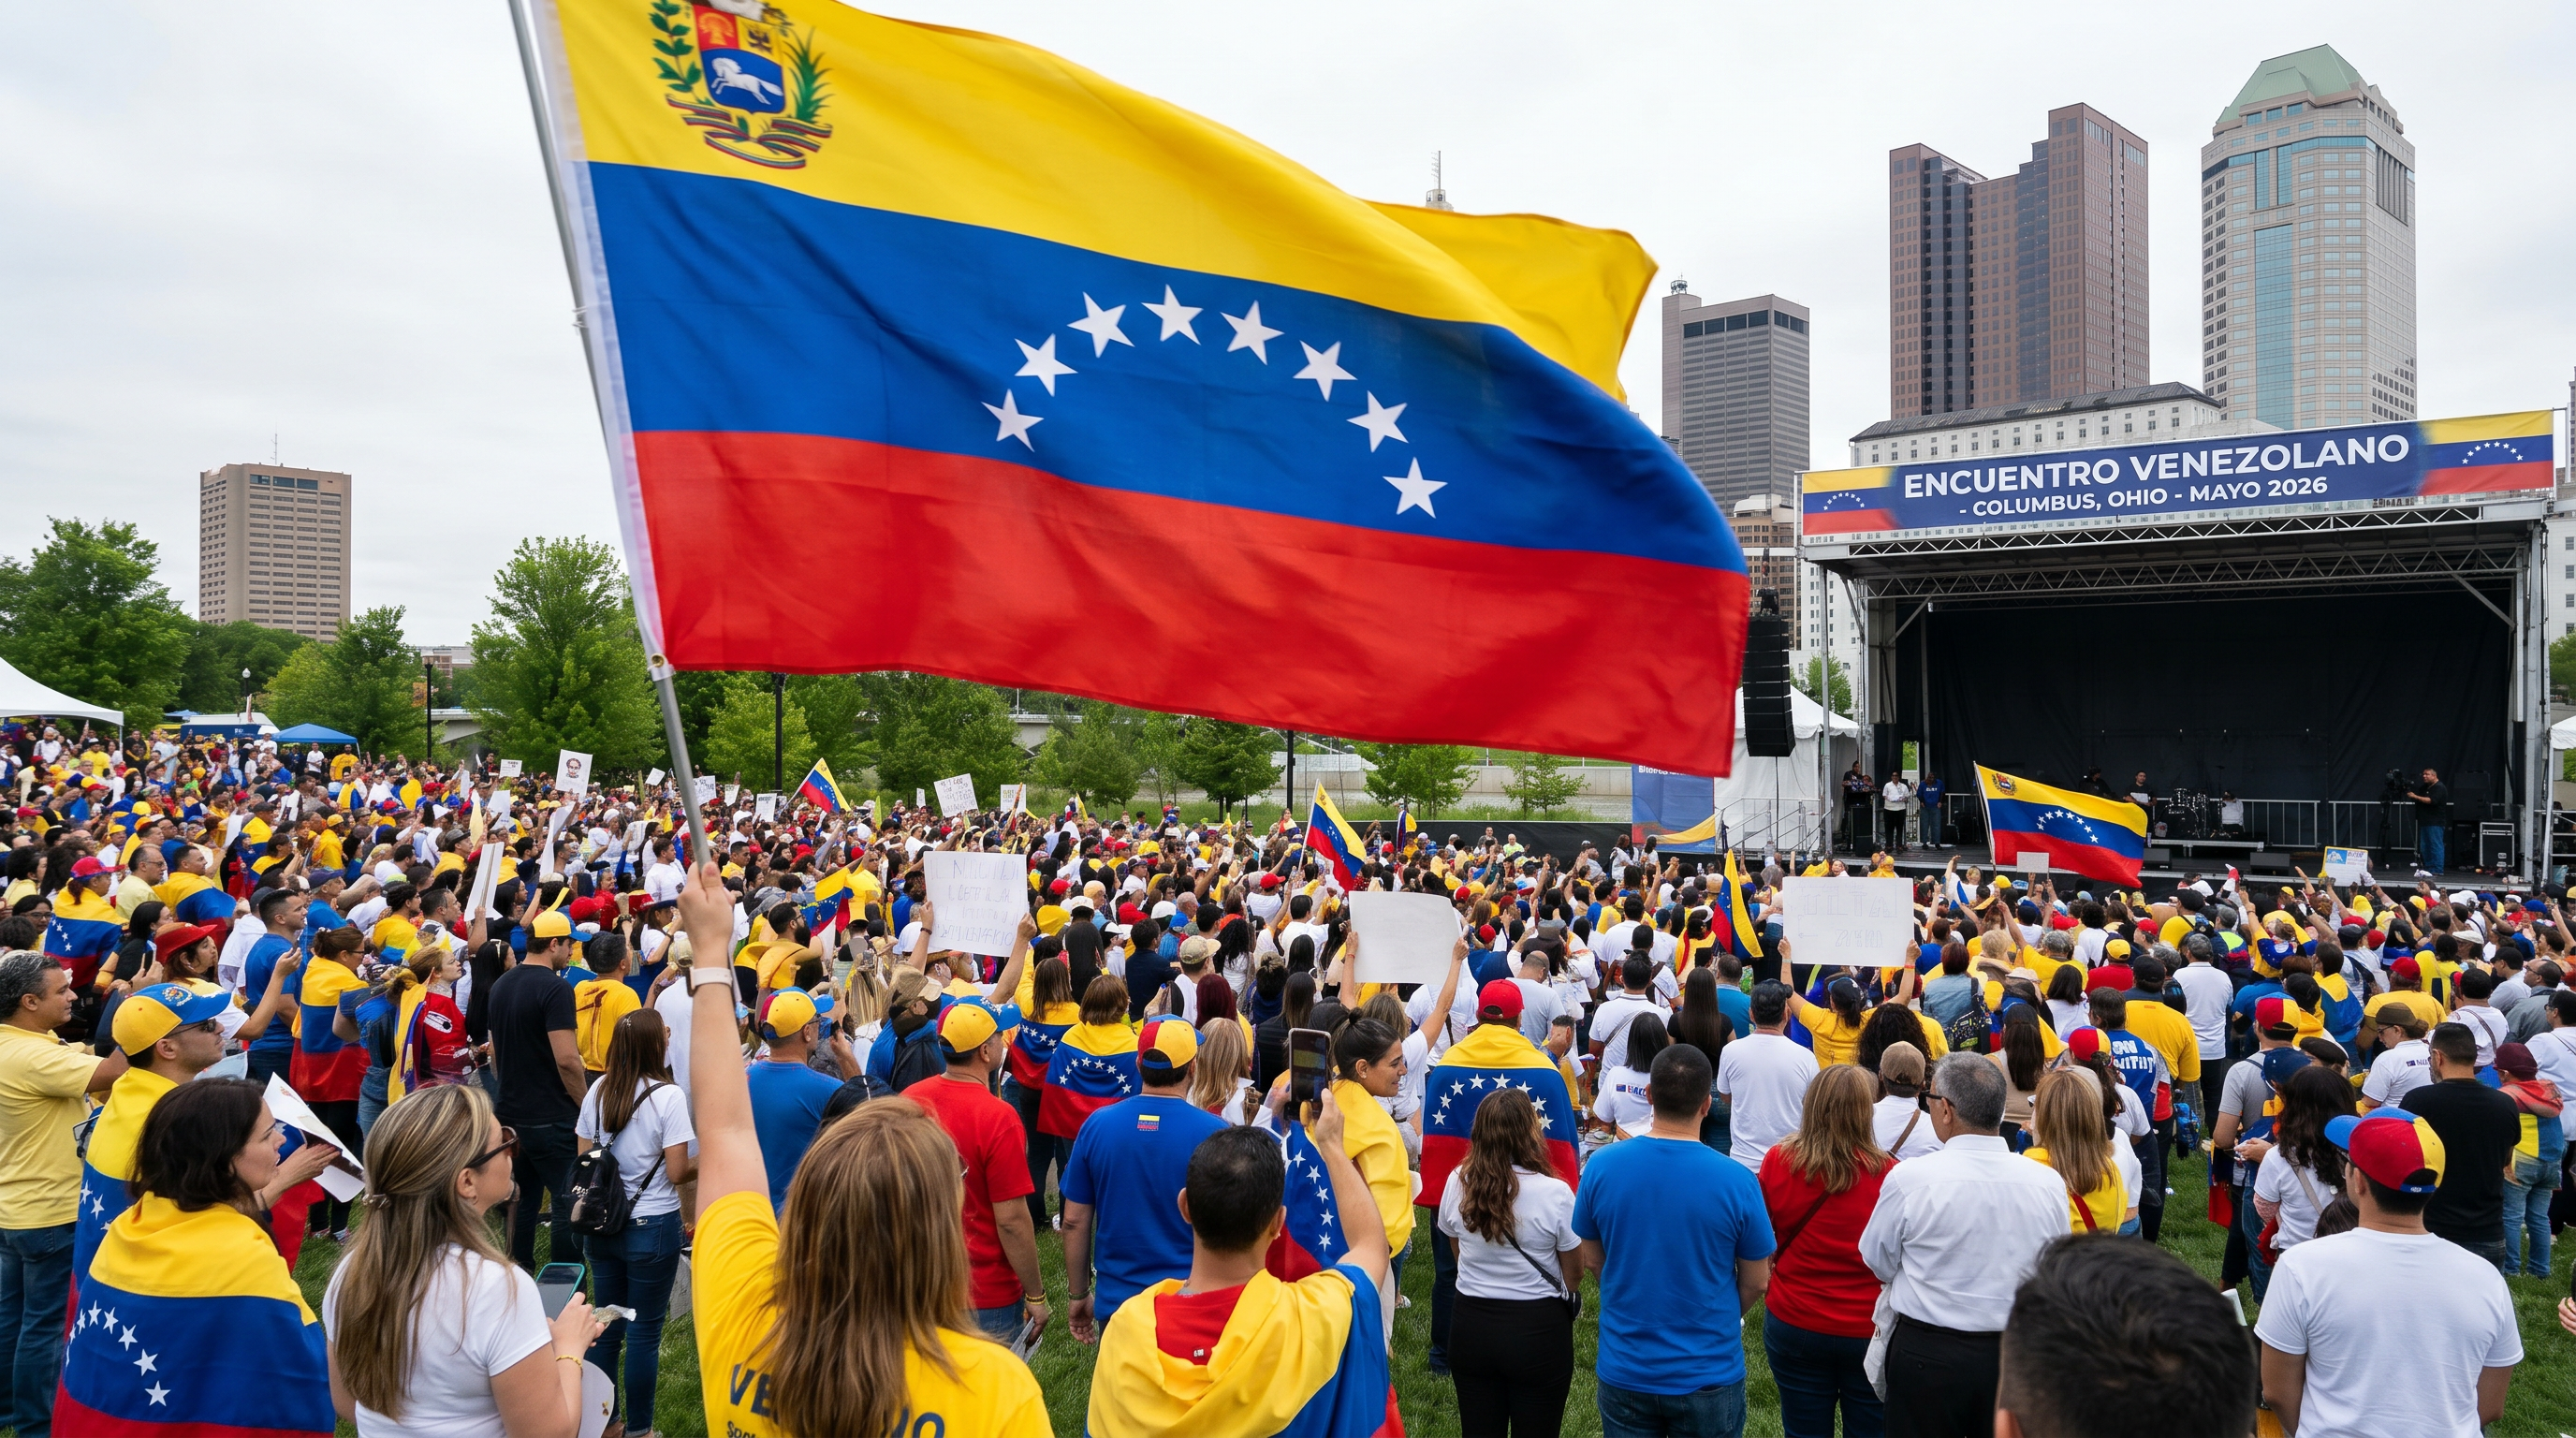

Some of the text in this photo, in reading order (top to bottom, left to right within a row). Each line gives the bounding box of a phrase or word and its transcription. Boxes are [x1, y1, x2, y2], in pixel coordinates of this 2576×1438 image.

[1905, 434, 2409, 499] ENCUENTRO VENEZOLANO
[1972, 492, 2101, 517] COLUMBUS,
[2107, 488, 2168, 507] OHIO
[2189, 481, 2261, 503] MAYO
[2267, 477, 2328, 497] 2026
